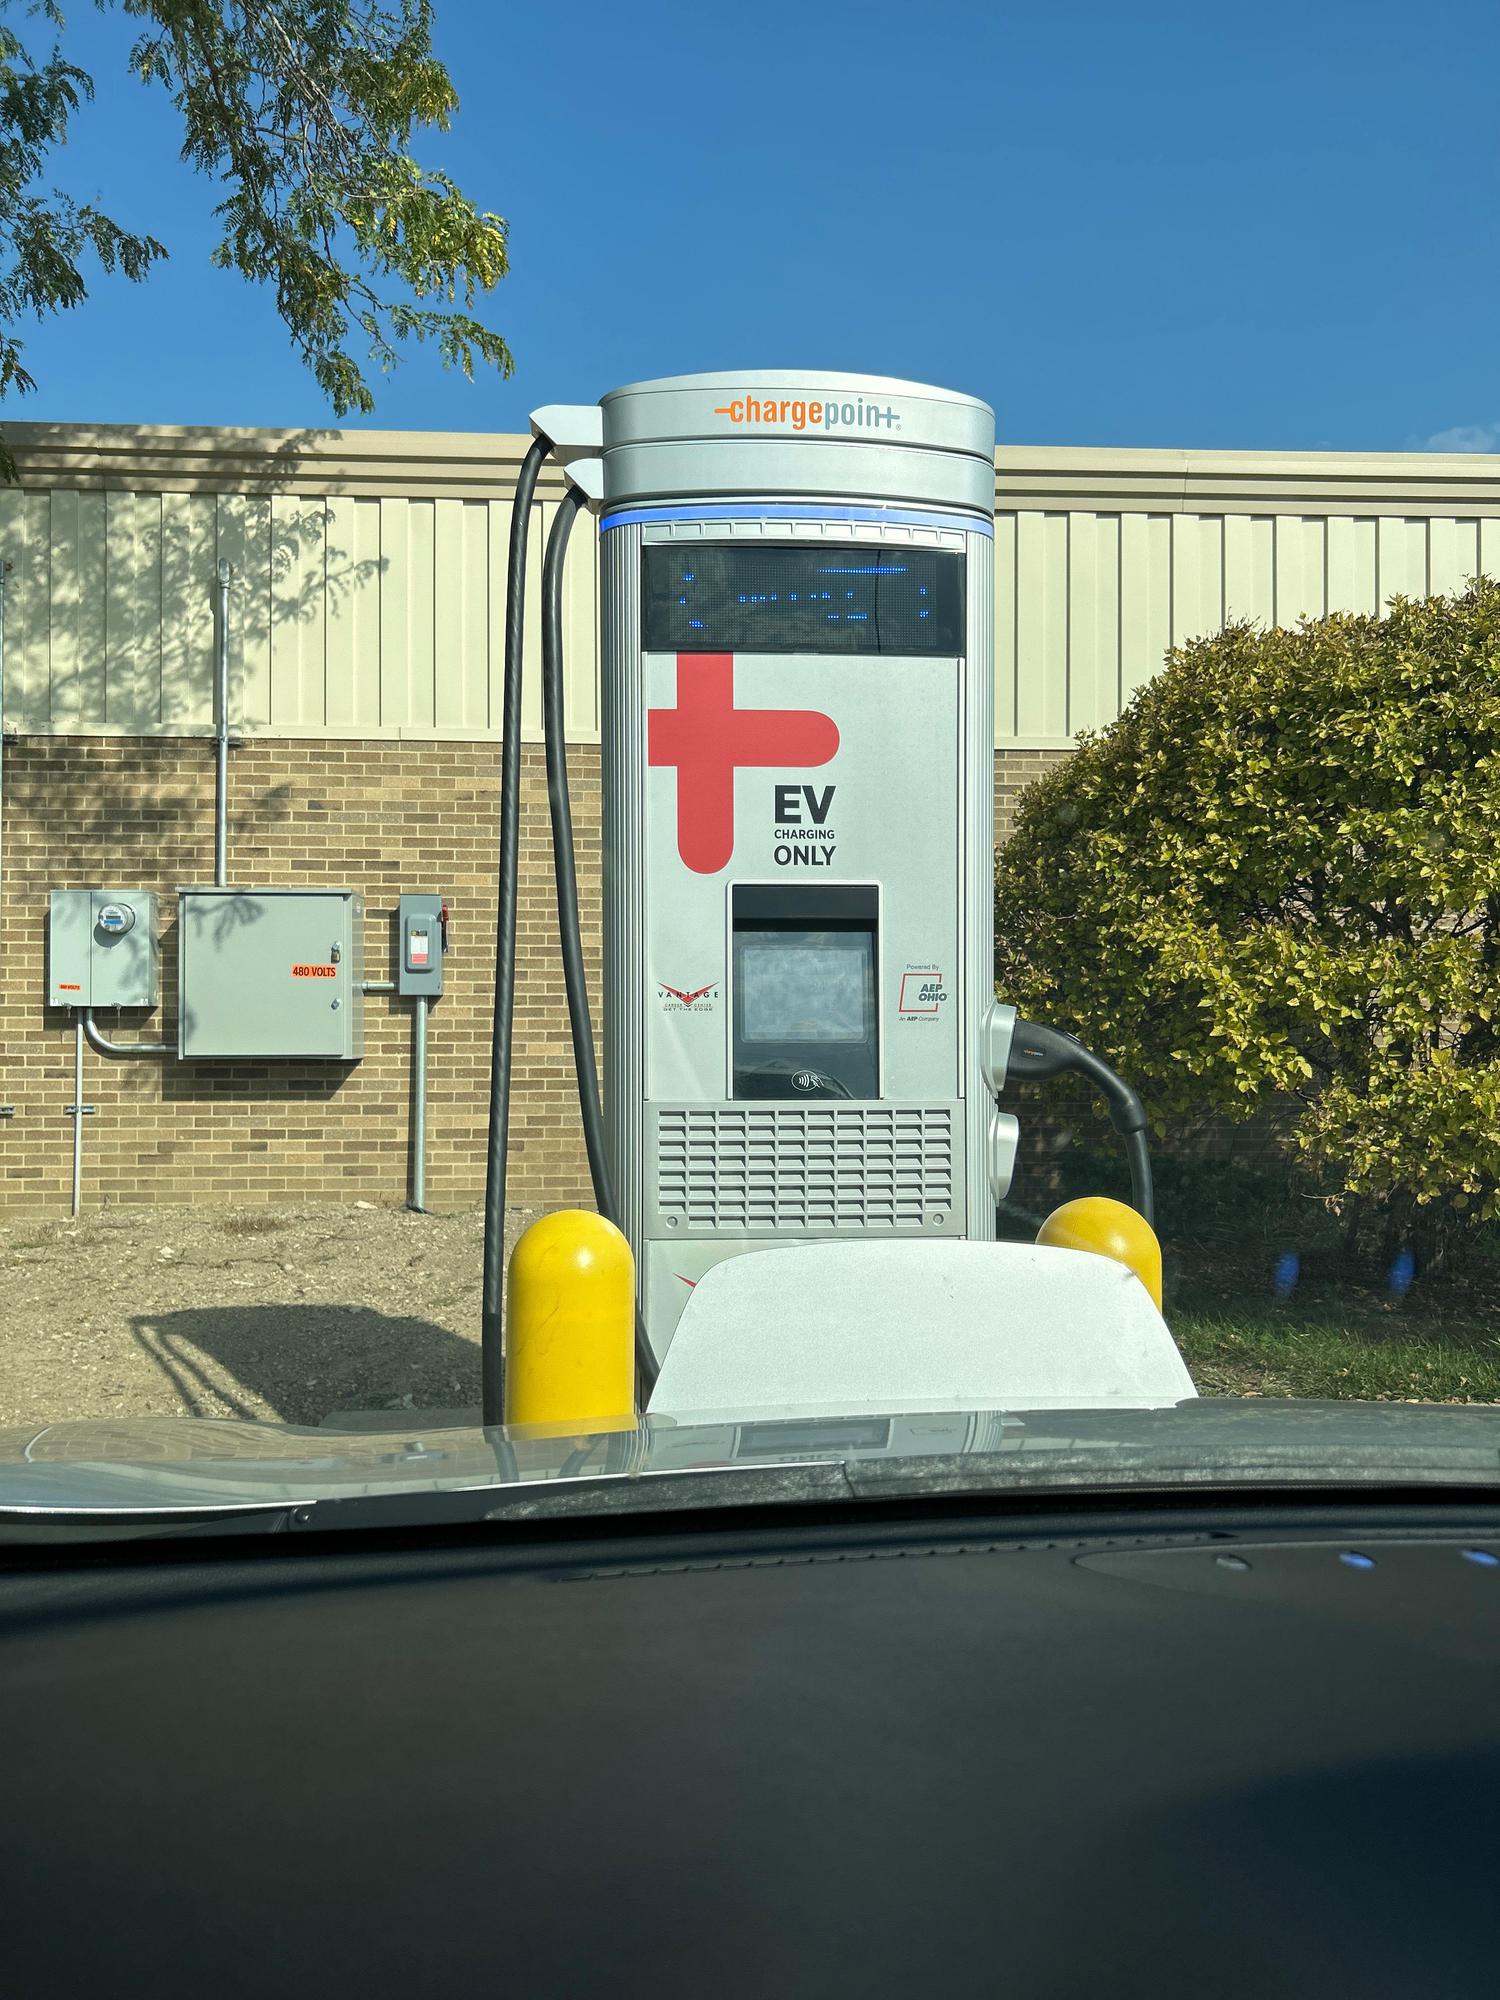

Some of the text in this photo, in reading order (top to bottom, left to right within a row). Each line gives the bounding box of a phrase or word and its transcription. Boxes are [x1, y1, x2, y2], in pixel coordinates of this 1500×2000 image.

[714, 395, 900, 430] chargepoint
[774, 785, 837, 824] EV
[774, 829, 835, 840] CHARGING
[773, 845, 837, 866] ONLY
[292, 966, 336, 977] 480 VOLTS
[920, 984, 943, 992] AEP
[918, 993, 947, 1001] OHIO
